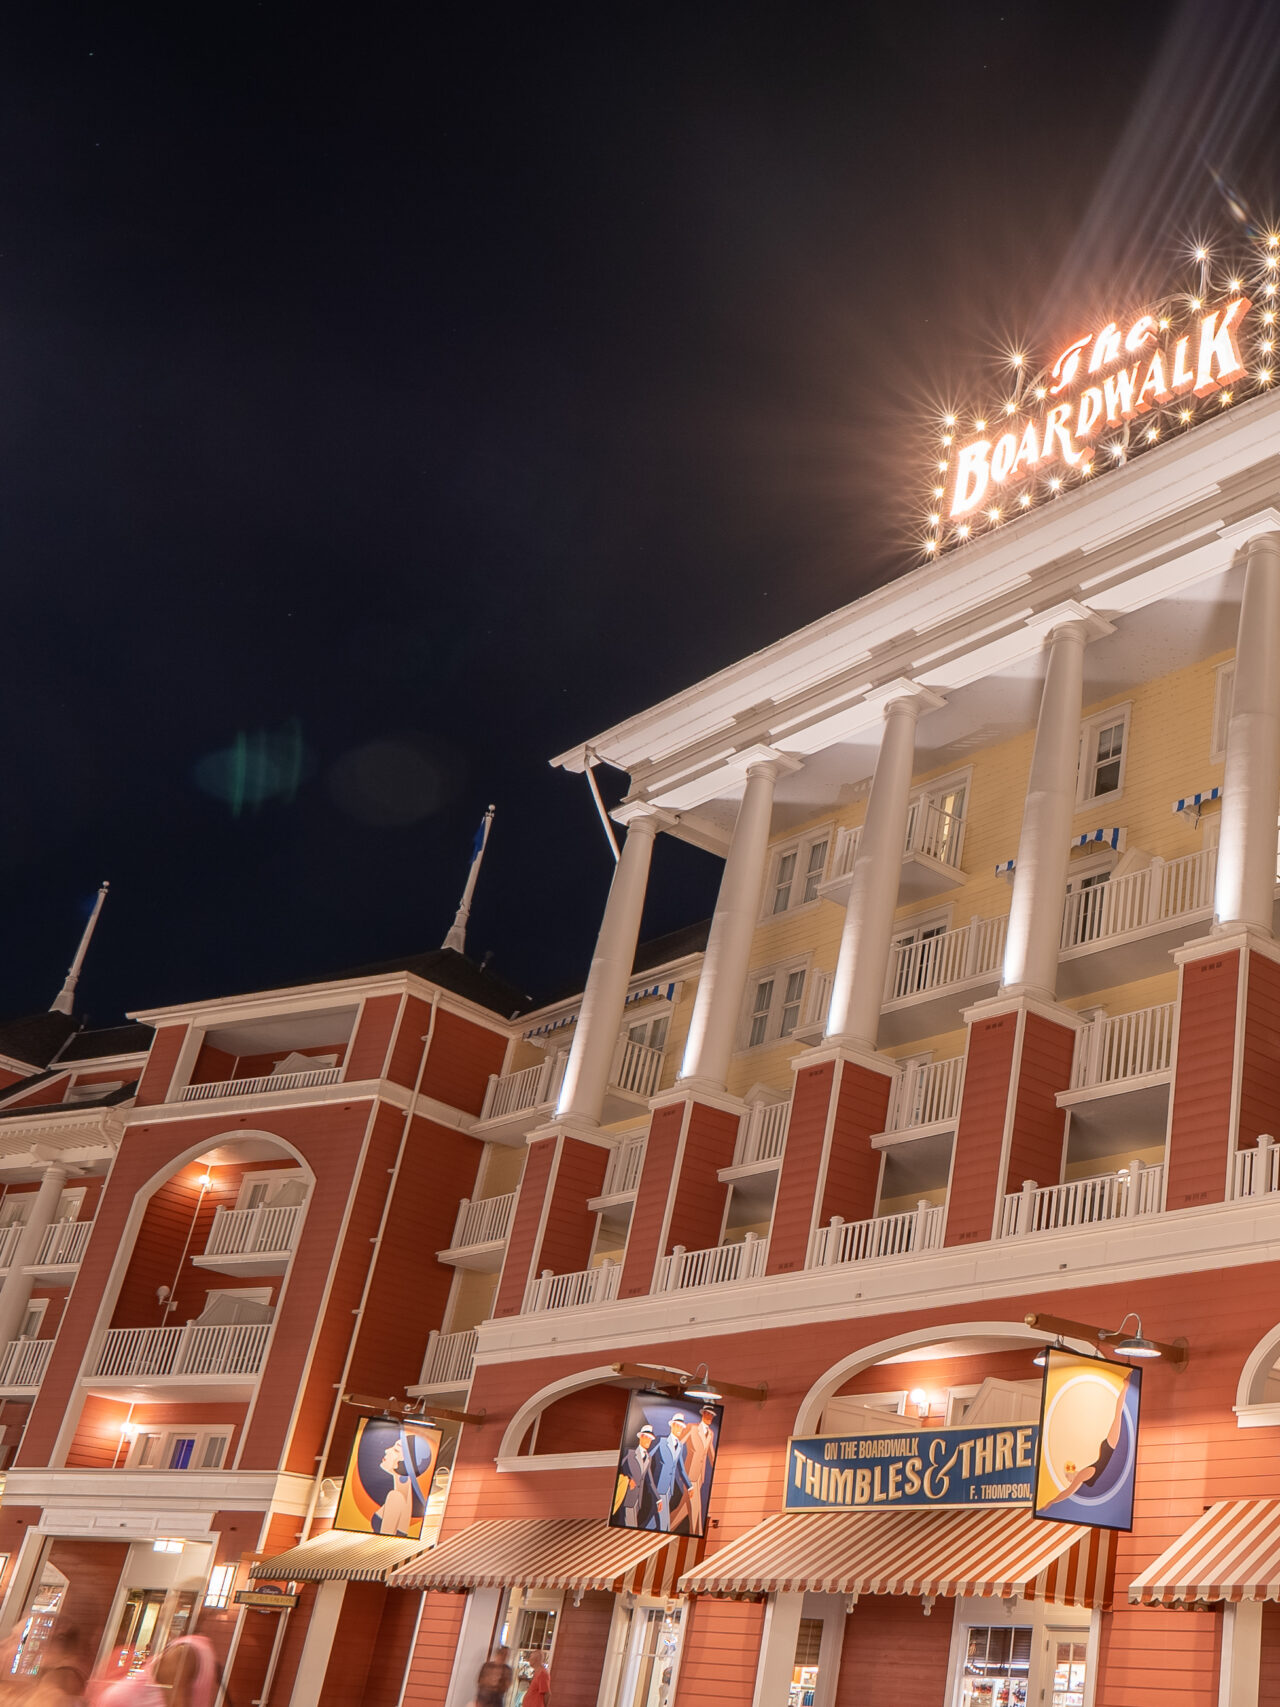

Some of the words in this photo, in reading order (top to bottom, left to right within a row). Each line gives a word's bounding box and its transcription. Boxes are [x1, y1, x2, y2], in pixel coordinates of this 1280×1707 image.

[1050, 315, 1158, 394] The
[949, 297, 1249, 521] BOARDWALK
[793, 1448, 923, 1505] THIMBLES
[923, 1438, 960, 1500] &
[958, 1427, 1039, 1480] THRE
[824, 1442, 838, 1461] ON
[840, 1441, 858, 1460] THE
[858, 1437, 920, 1459] BOARDWALK
[970, 1485, 978, 1500] F.
[981, 1483, 1033, 1501] THOMPSON,
